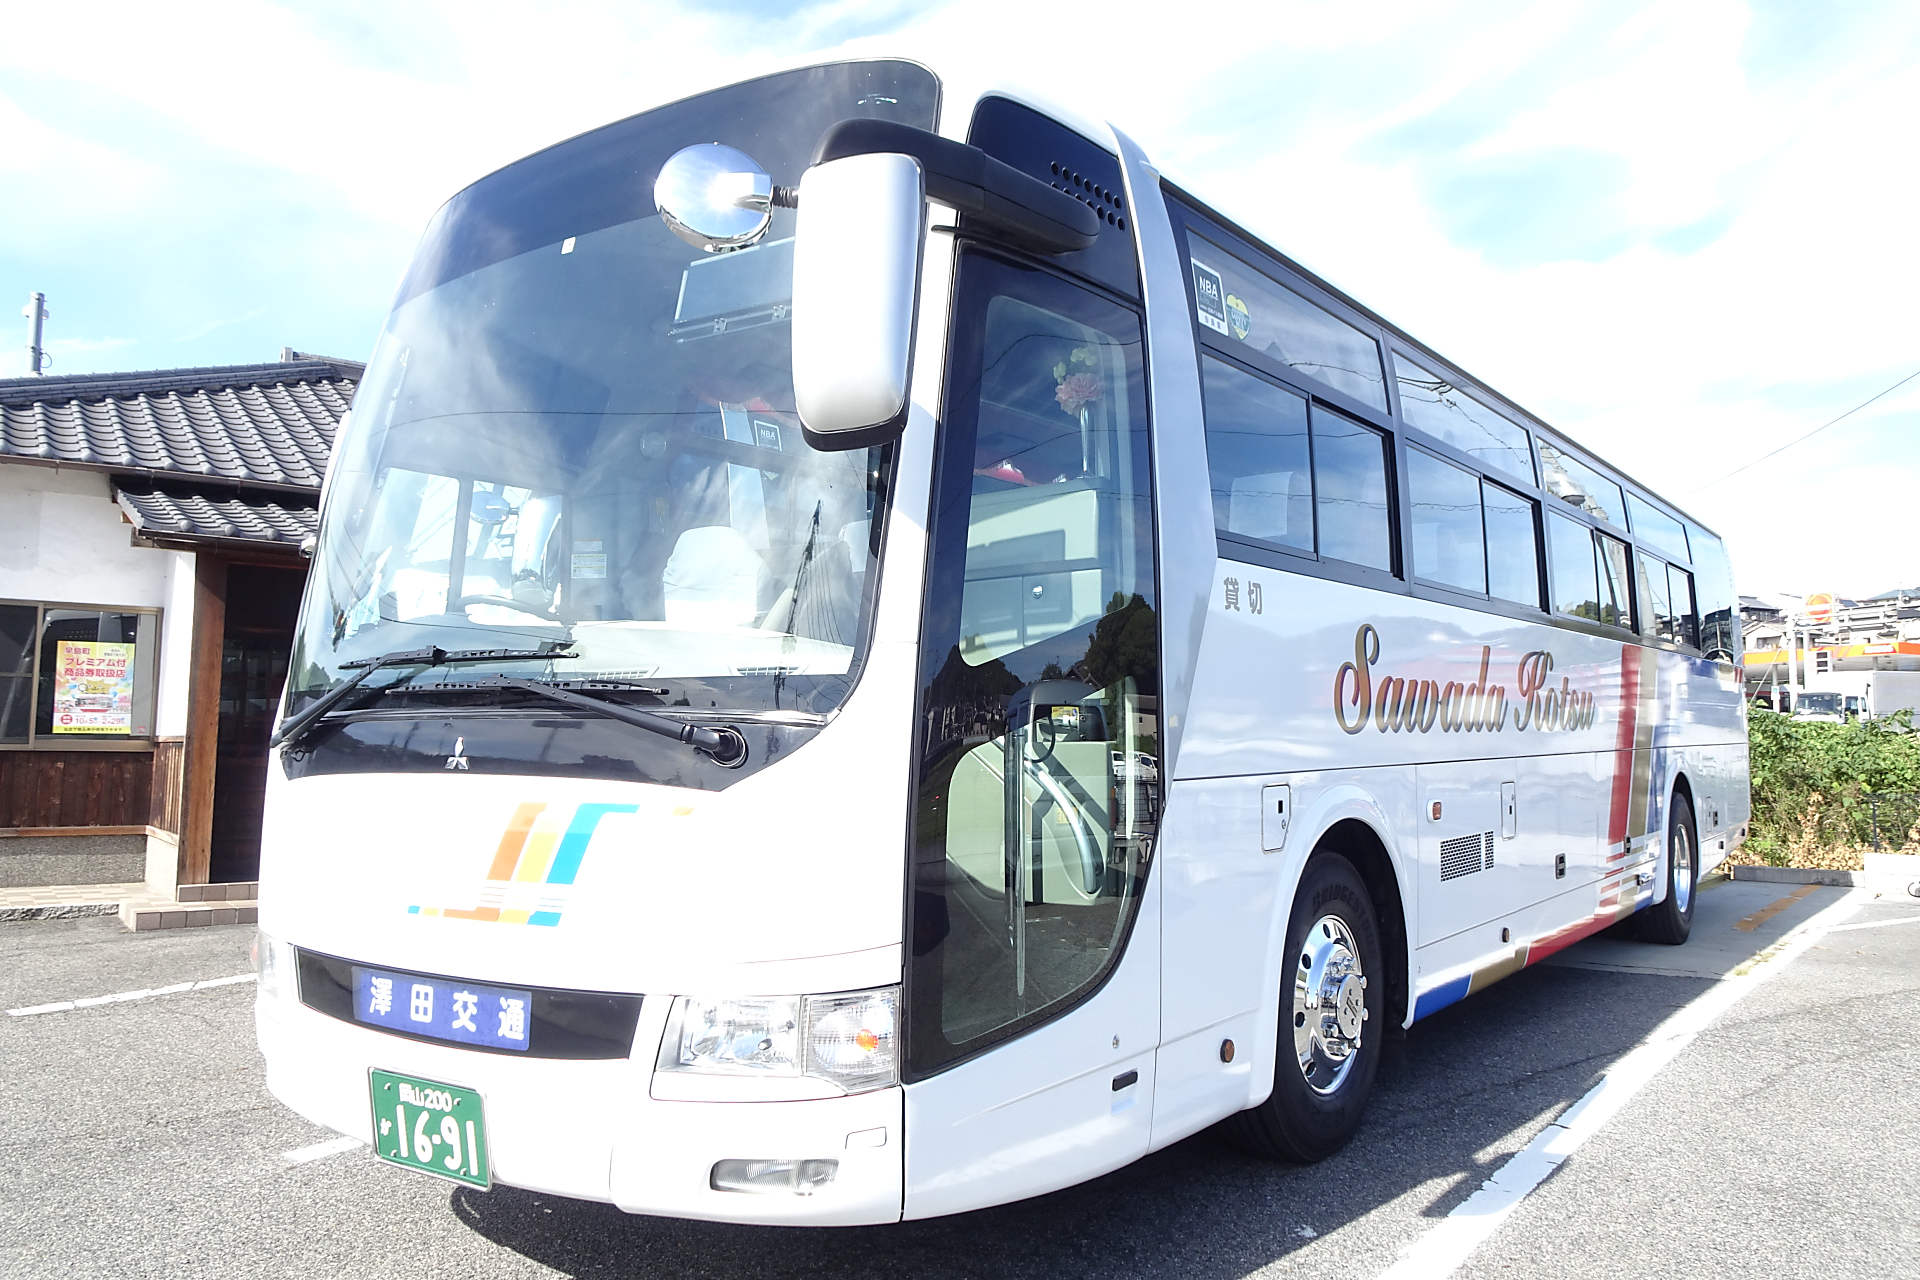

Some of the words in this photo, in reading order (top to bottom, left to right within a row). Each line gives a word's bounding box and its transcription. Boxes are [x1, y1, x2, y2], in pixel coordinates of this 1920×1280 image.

[1200, 276, 1218, 298] NBA
[1223, 577, 1263, 615] 貸切
[65, 658, 126, 667] プレミアム付
[1334, 623, 1508, 735] Sawada
[1514, 650, 1596, 732] Kotsu
[369, 976, 525, 1041] 澤田交通
[396, 1104, 478, 1176] 16-91
